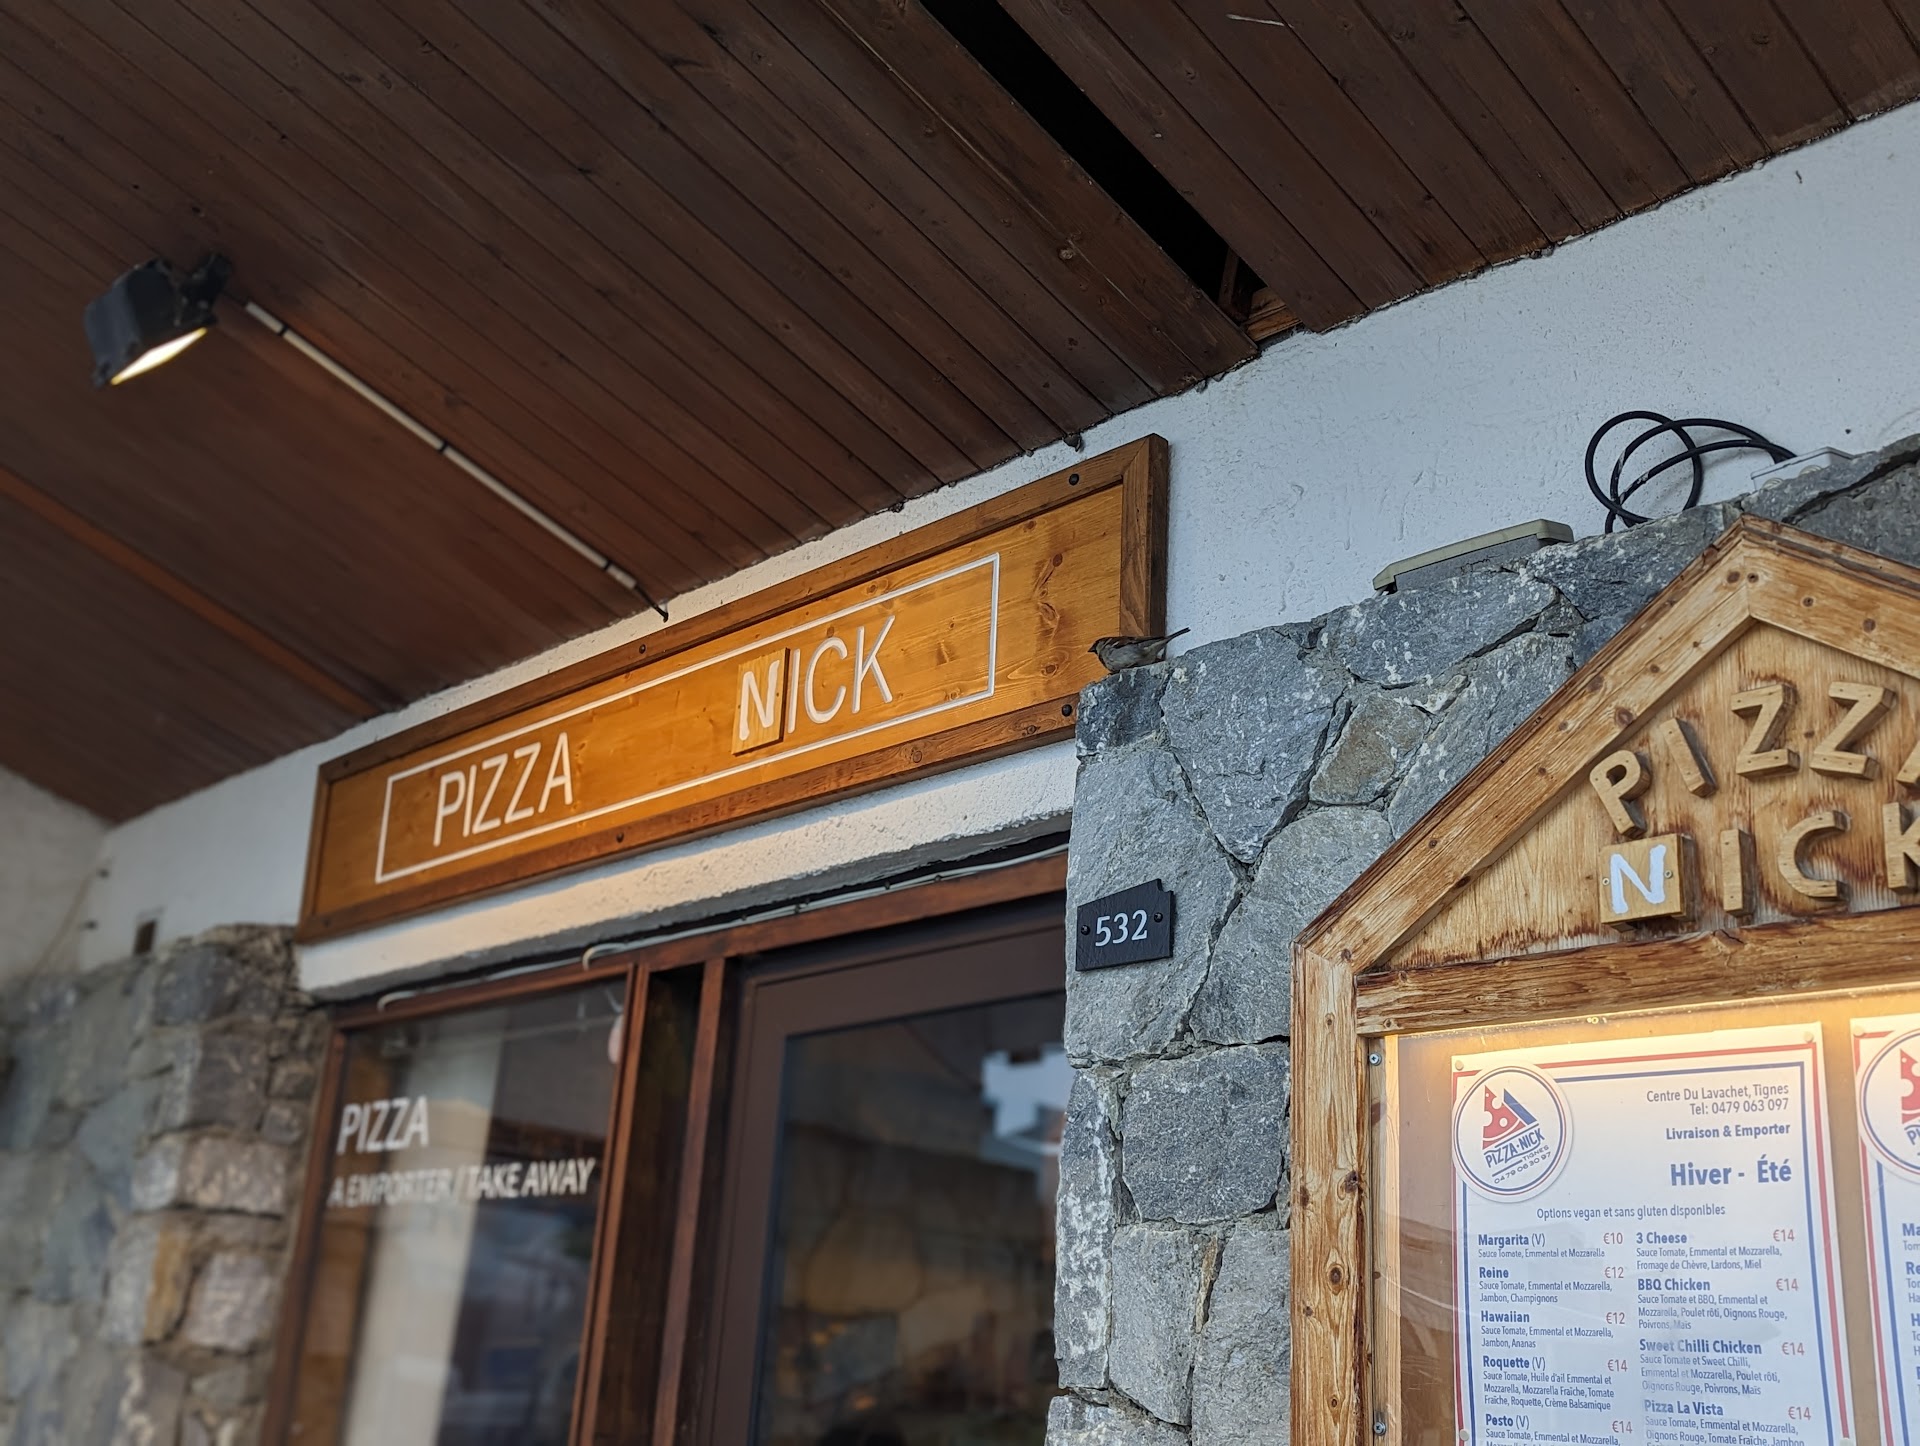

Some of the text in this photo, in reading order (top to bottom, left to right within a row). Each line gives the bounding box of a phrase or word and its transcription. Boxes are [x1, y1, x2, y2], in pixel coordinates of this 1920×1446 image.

[433, 614, 896, 847] PIZZA NICK
[1590, 681, 1920, 836] PIZZ
[1095, 909, 1148, 947] 532
[1646, 1084, 1789, 1102] Centre Du Lavachet, Tignes
[1689, 1097, 1789, 1115] Tel: 0479 063 097
[336, 1094, 430, 1155] PIZZA
[1665, 1123, 1791, 1140] Livraison & Emporter
[1522, 1144, 1549, 1161] TIGNES
[1670, 1161, 1732, 1186] Hiver
[1757, 1153, 1792, 1183] Été
[344, 1168, 454, 1208] EMPORTER
[462, 1161, 523, 1199] TAKE
[521, 1157, 596, 1198] AWAY
[1536, 1203, 1726, 1221] Options vegan et sans gluten disponibles
[1478, 1232, 1623, 1249] Margarita (V) €10
[1636, 1229, 1795, 1244] 3 Cheese €14
[1478, 1248, 1497, 1258] Sauce
[1525, 1248, 1559, 1258] Emmental
[1560, 1249, 1567, 1257] et
[1568, 1248, 1605, 1258] Mozzarella
[1636, 1245, 1782, 1258] Sauce Tomate, Emmental et Mozzarella,
[1479, 1266, 1624, 1279] Reine €12
[1636, 1259, 1762, 1273] Fromage de Chèvre, Lardons, Miel
[1479, 1281, 1613, 1292] Sauce Tomate, Emmental et Mozzarella,
[1637, 1278, 1799, 1291] BBQ Chicken €14
[1480, 1293, 1558, 1305] Jambon, Champignons
[1637, 1294, 1659, 1304] Sauce
[1660, 1294, 1687, 1304] Tomate
[1688, 1295, 1697, 1304] et
[1718, 1294, 1758, 1305] Emmental
[1759, 1296, 1768, 1305] et
[1481, 1310, 1626, 1325] Hawaiian €12
[1638, 1307, 1788, 1320] Mozzarella, Poulet rôti, Oignons Rouge,
[1481, 1325, 1614, 1338] Sauce Tomate, Emmental et Mozzarella,
[1638, 1319, 1672, 1330] Poivrons,
[1481, 1338, 1536, 1349] Jambon, Ananas
[1639, 1338, 1805, 1356] Sweet Chilli Chicken €14
[1482, 1355, 1628, 1372] Roquette (V) €14
[1640, 1354, 1751, 1368] Sauce Tomate et Sweet Chilli,
[1483, 1371, 1503, 1381] Sauce
[1503, 1371, 1530, 1382] Tomate,
[1530, 1372, 1550, 1382] Huile
[1566, 1373, 1603, 1384] Emmental
[1604, 1375, 1612, 1385] et
[1640, 1367, 1780, 1383] Emmental et Mozzarella, Poulet rôti,
[1483, 1383, 1521, 1395] Mozzarella,
[1522, 1384, 1559, 1395] Mozzarella
[1587, 1387, 1615, 1398] Tomate
[1642, 1380, 1675, 1393] Oignons
[1675, 1381, 1703, 1395] Rouge,
[1703, 1383, 1741, 1395] Poivrons,
[1511, 1396, 1544, 1408] Roquette,
[1544, 1397, 1568, 1408] Crème
[1568, 1398, 1612, 1412] Balsamique
[1644, 1399, 1812, 1420] Pizza La Vista €14
[1485, 1413, 1633, 1434] Pesto (V) €14
[1645, 1416, 1799, 1435] Sauce Tomate, Emmental et Mozzarella,
[1485, 1428, 1506, 1439] Sauce
[1506, 1429, 1533, 1441] Tomate,
[1534, 1431, 1570, 1442] Emmental
[1571, 1433, 1579, 1443] et
[1579, 1433, 1620, 1446] Mozzarella,
[1646, 1429, 1678, 1442] Oignons
[1679, 1431, 1707, 1444] Rouge,
[1707, 1433, 1737, 1445] Tomate
